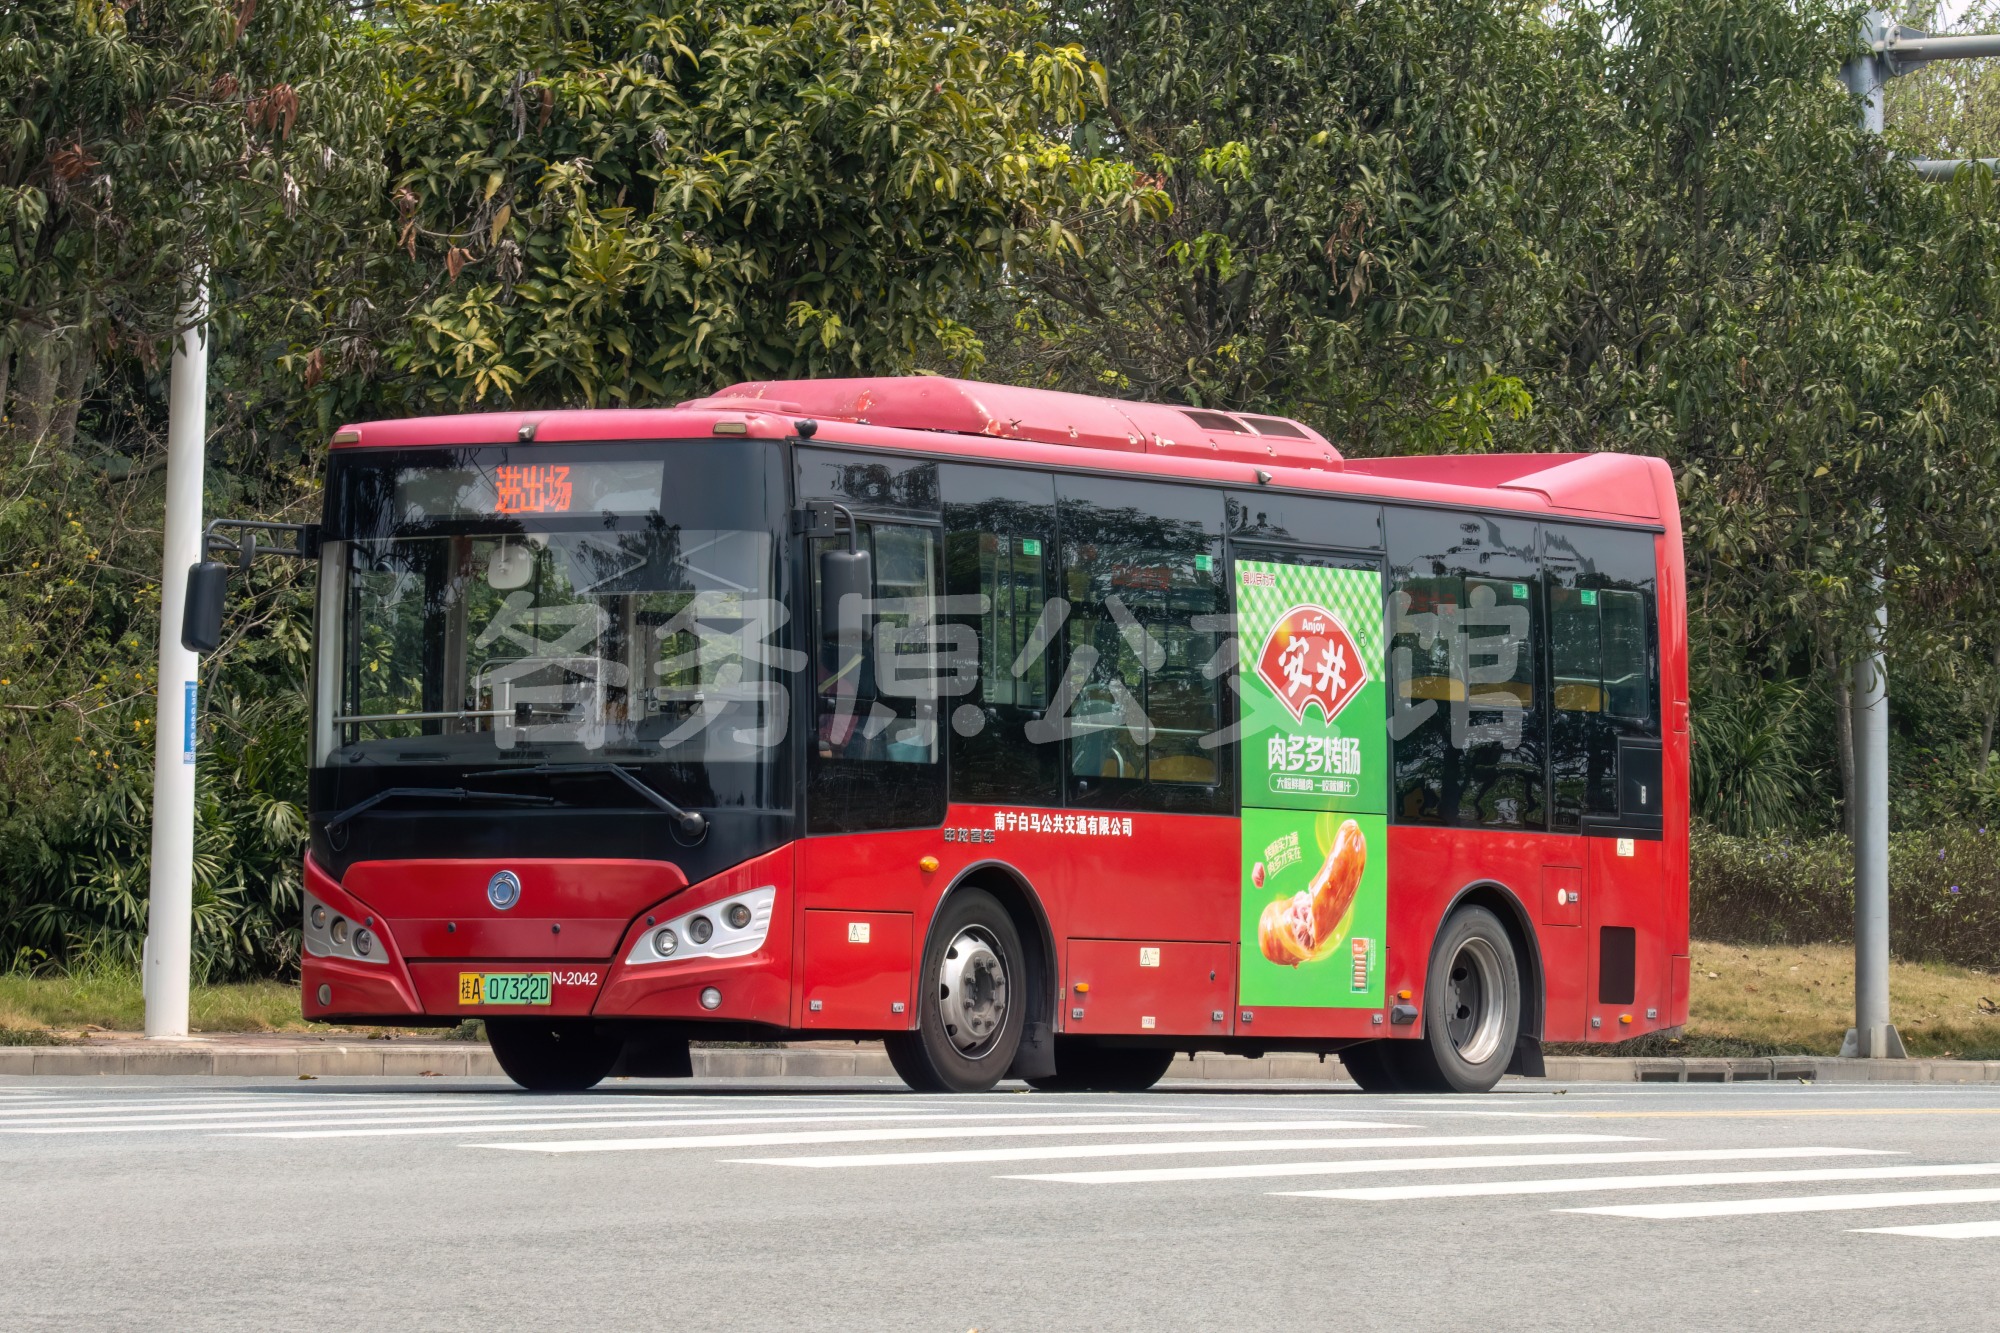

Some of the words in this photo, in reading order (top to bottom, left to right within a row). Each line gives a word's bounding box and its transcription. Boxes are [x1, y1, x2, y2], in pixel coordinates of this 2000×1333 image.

[494, 464, 573, 514] 进出场
[1302, 615, 1325, 635] Anjoy
[1278, 635, 1346, 702] 安井
[1267, 733, 1361, 775] 肉多多烤肠
[943, 827, 996, 844] 申龙客车
[994, 811, 1132, 837] 南宁白马公共交通有限公司
[461, 978, 481, 1000] 桂A
[489, 977, 549, 1000] 07322D
[552, 972, 598, 986] N-2042
